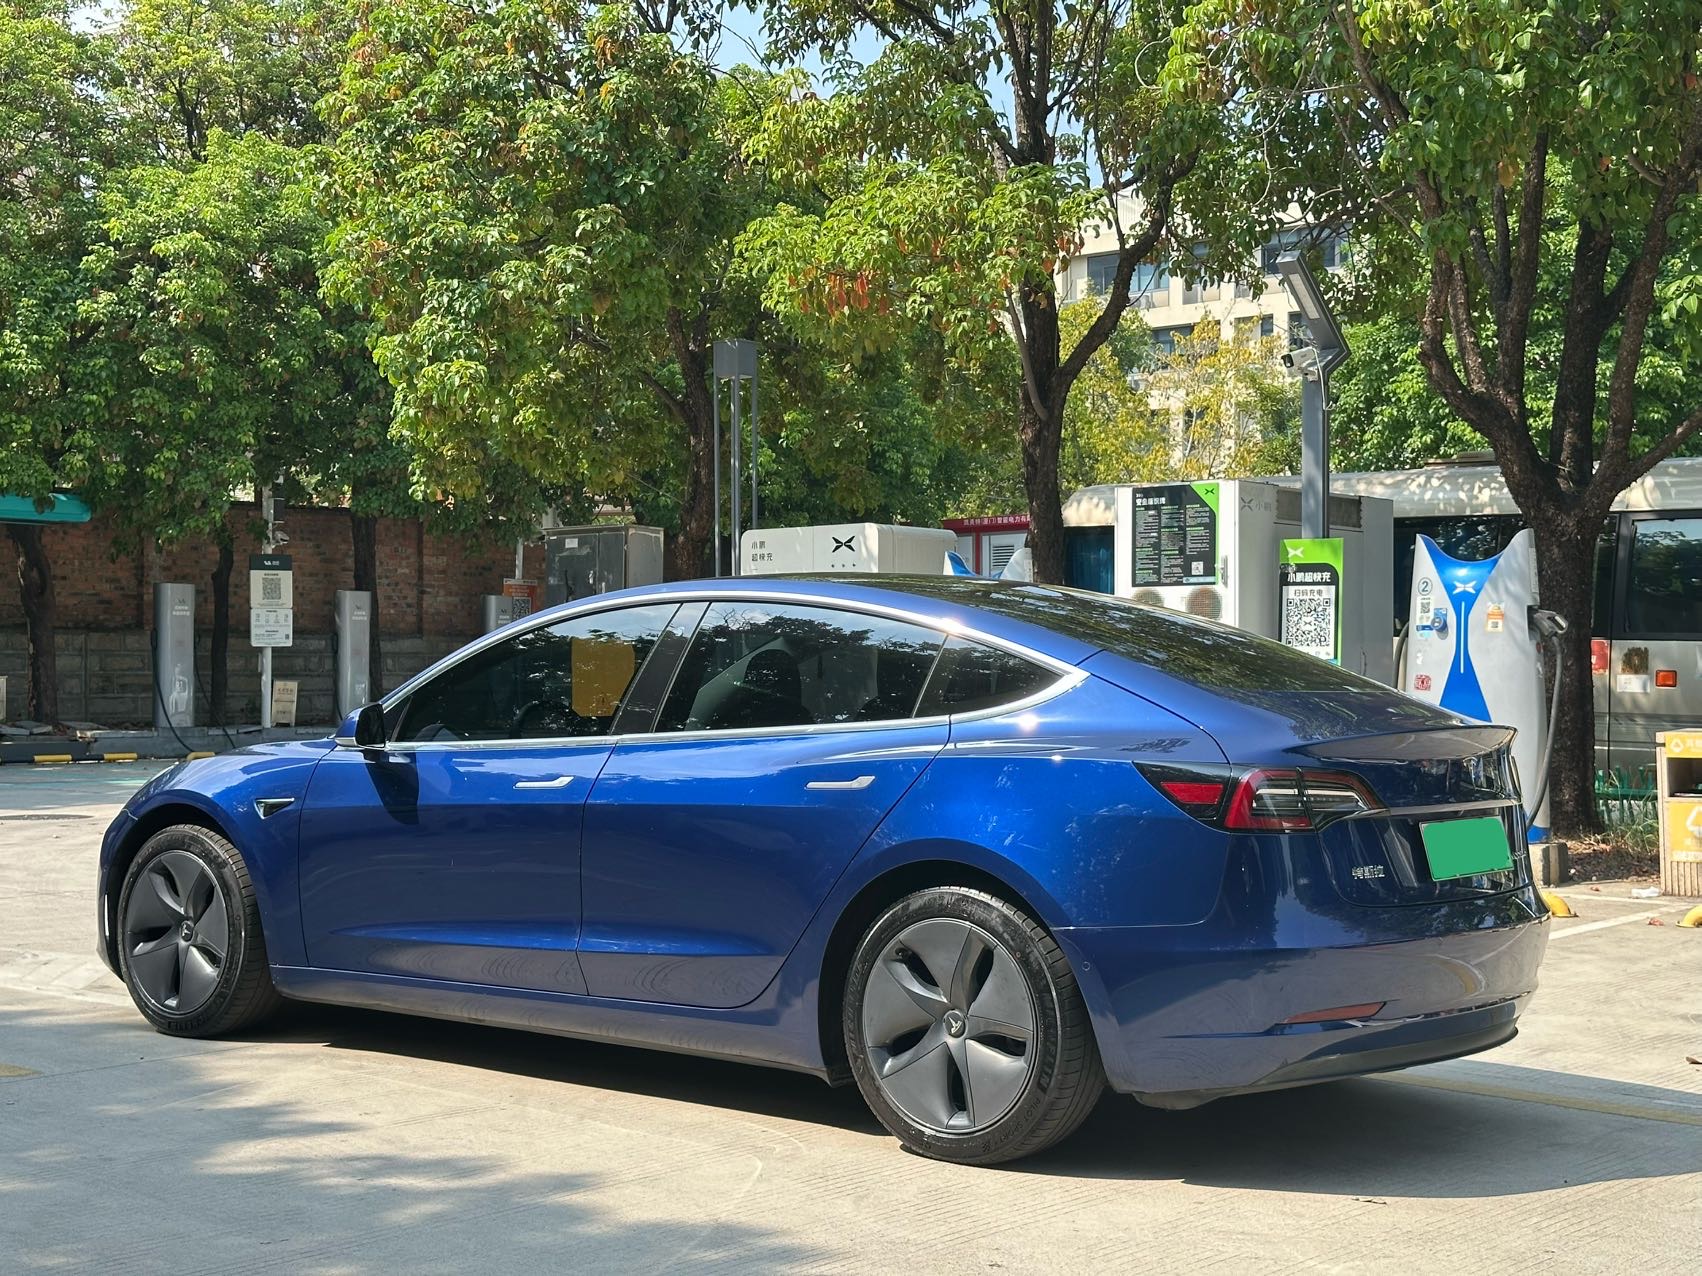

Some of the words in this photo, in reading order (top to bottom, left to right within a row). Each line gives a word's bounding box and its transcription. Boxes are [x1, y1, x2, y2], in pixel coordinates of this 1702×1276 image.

[751, 541, 766, 550] 小鹏
[751, 552, 773, 562] 超快充
[1287, 571, 1331, 583] 小鹏超快充
